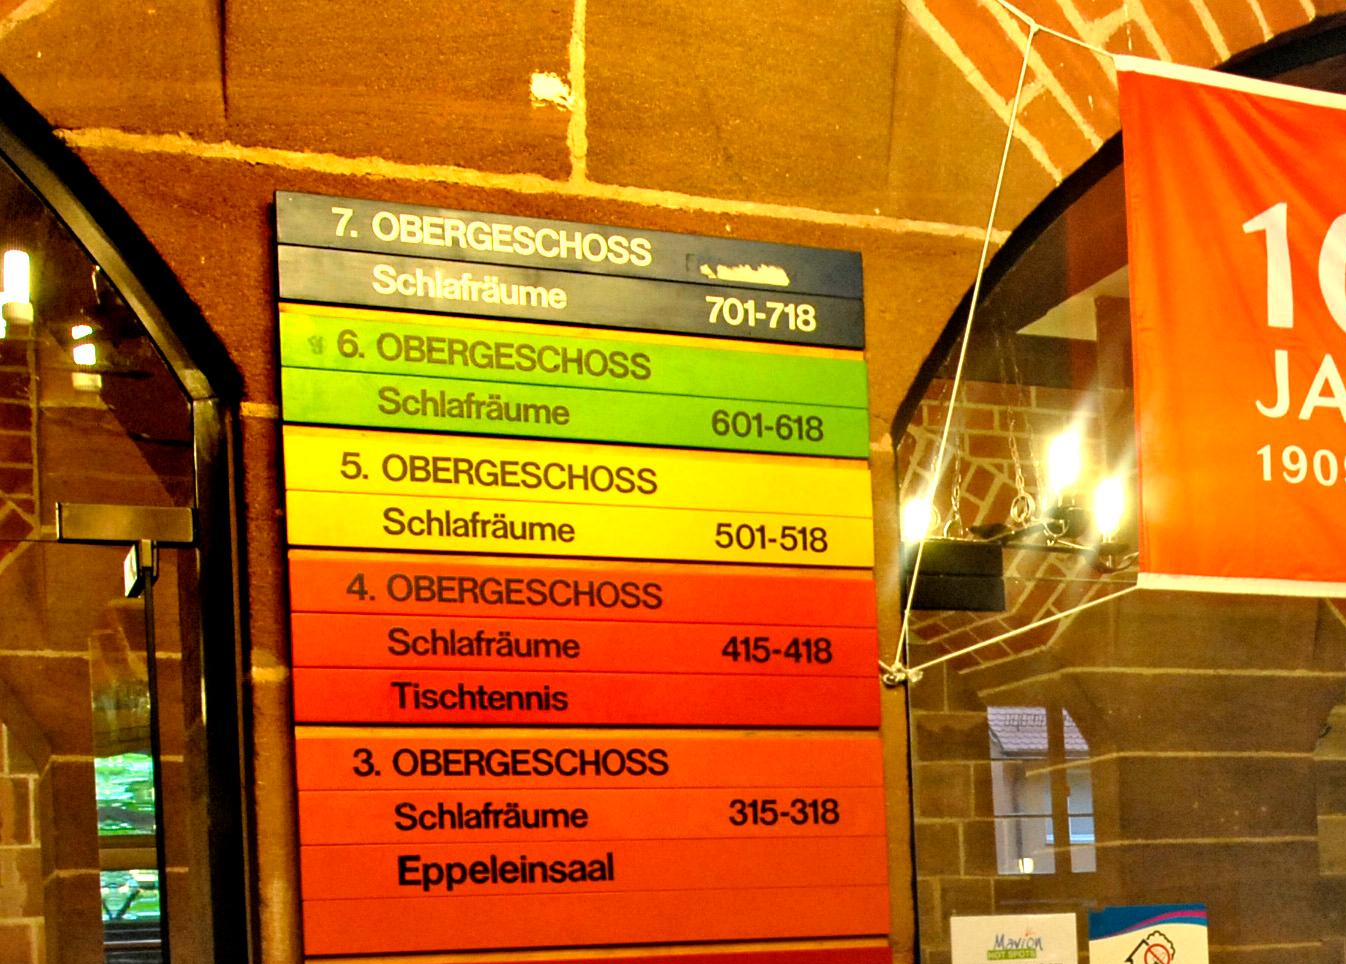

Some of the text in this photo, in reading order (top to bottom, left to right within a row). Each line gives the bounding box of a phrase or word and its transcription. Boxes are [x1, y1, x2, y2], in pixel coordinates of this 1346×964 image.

[331, 207, 652, 267] 7. OBERGESCHOSS
[372, 265, 816, 332] Schlafräume 701-718
[337, 329, 651, 381] 6. OBERGESCHOSS
[378, 387, 824, 442] Schlafräume 601-618
[341, 451, 657, 495] 5. OBERGESCHOSS
[382, 508, 828, 553] Schlafräume 501-518
[346, 573, 662, 609] 4. OBERGESCHOSS
[387, 628, 832, 664] Schlafräume 415-418
[390, 681, 568, 712] Tischtennis
[352, 748, 669, 777] 3. OBERGESCHOSS
[394, 798, 839, 831] Schlafräume 315-318
[397, 852, 615, 892] Eppeleinsaal
